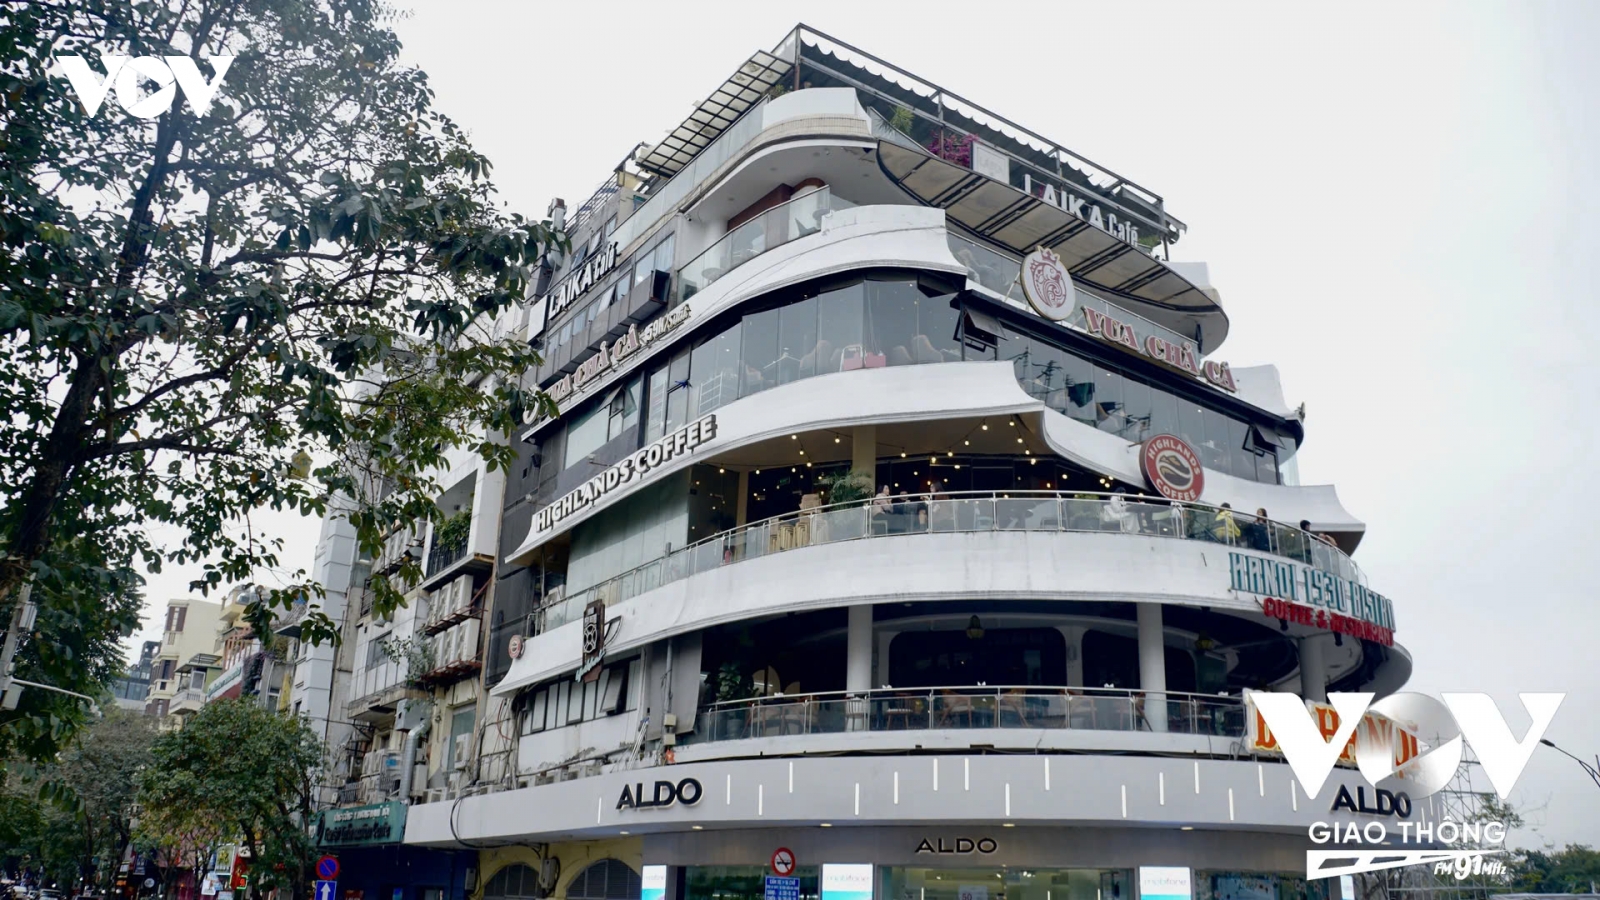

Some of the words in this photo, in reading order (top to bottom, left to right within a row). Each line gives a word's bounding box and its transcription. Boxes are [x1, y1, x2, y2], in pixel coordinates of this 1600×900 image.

[1108, 213, 1138, 247] Café
[548, 261, 595, 320] LAIKA
[1081, 306, 1140, 350] VUA
[1145, 335, 1199, 376] CHẢ
[536, 459, 634, 533] HIGHLANDS
[634, 414, 717, 474] COFFEE
[1148, 439, 1200, 476] HIGHLANDS
[1156, 478, 1196, 501] COFFEE
[1229, 552, 1299, 601] HANOI
[1304, 567, 1348, 613] 1930
[1350, 581, 1396, 633] BISTRO
[616, 778, 703, 811] ALDO
[1330, 784, 1412, 818] ALDO
[915, 837, 998, 854] ALDO
